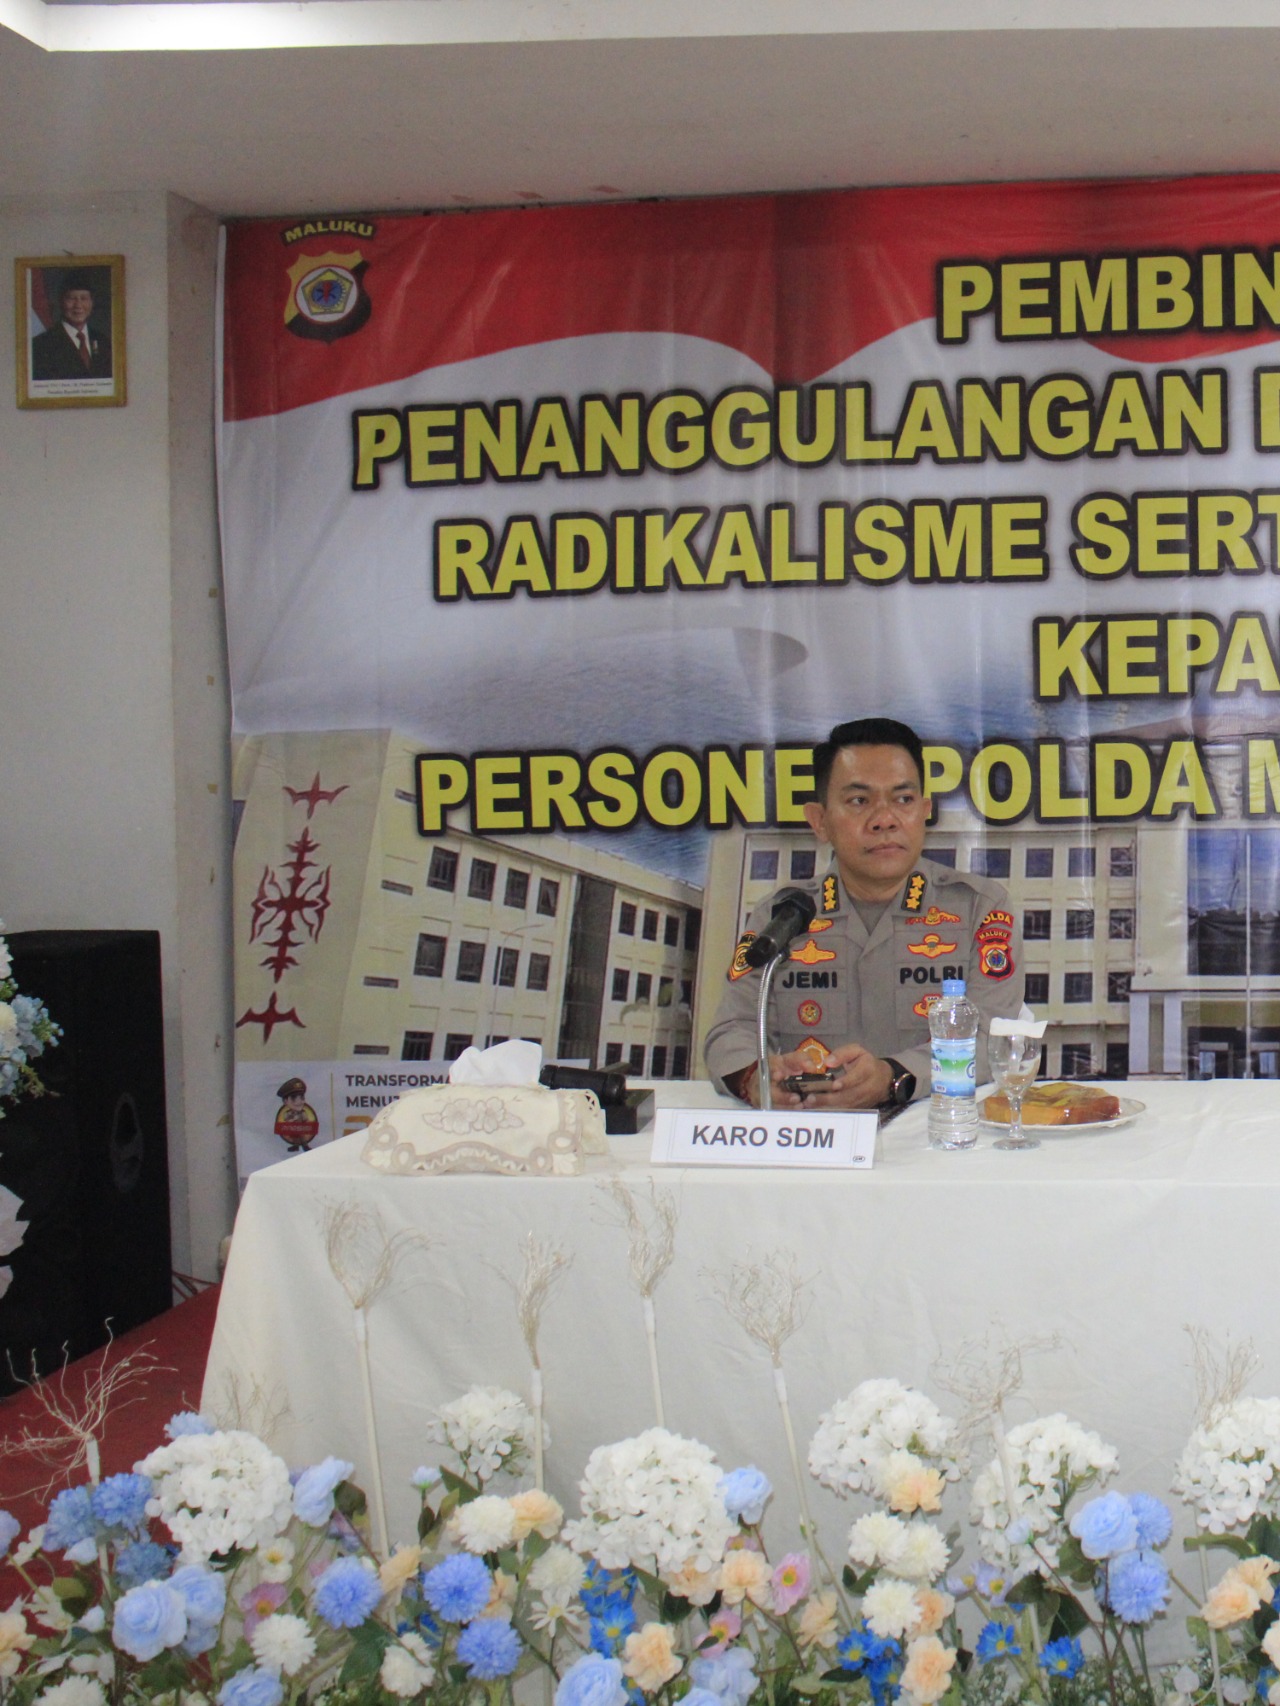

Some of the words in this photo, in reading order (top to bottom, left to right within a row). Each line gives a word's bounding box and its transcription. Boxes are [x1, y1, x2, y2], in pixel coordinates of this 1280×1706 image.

[285, 220, 373, 243] MALUKU
[354, 375, 1224, 486] PENANGGULANGAN
[437, 502, 1044, 597] RADIKALISME
[921, 740, 1219, 820] POLDA
[782, 971, 838, 989] JEMI
[900, 965, 964, 985] POLRI
[691, 1125, 768, 1148] KARO
[776, 1126, 834, 1149] SDM
